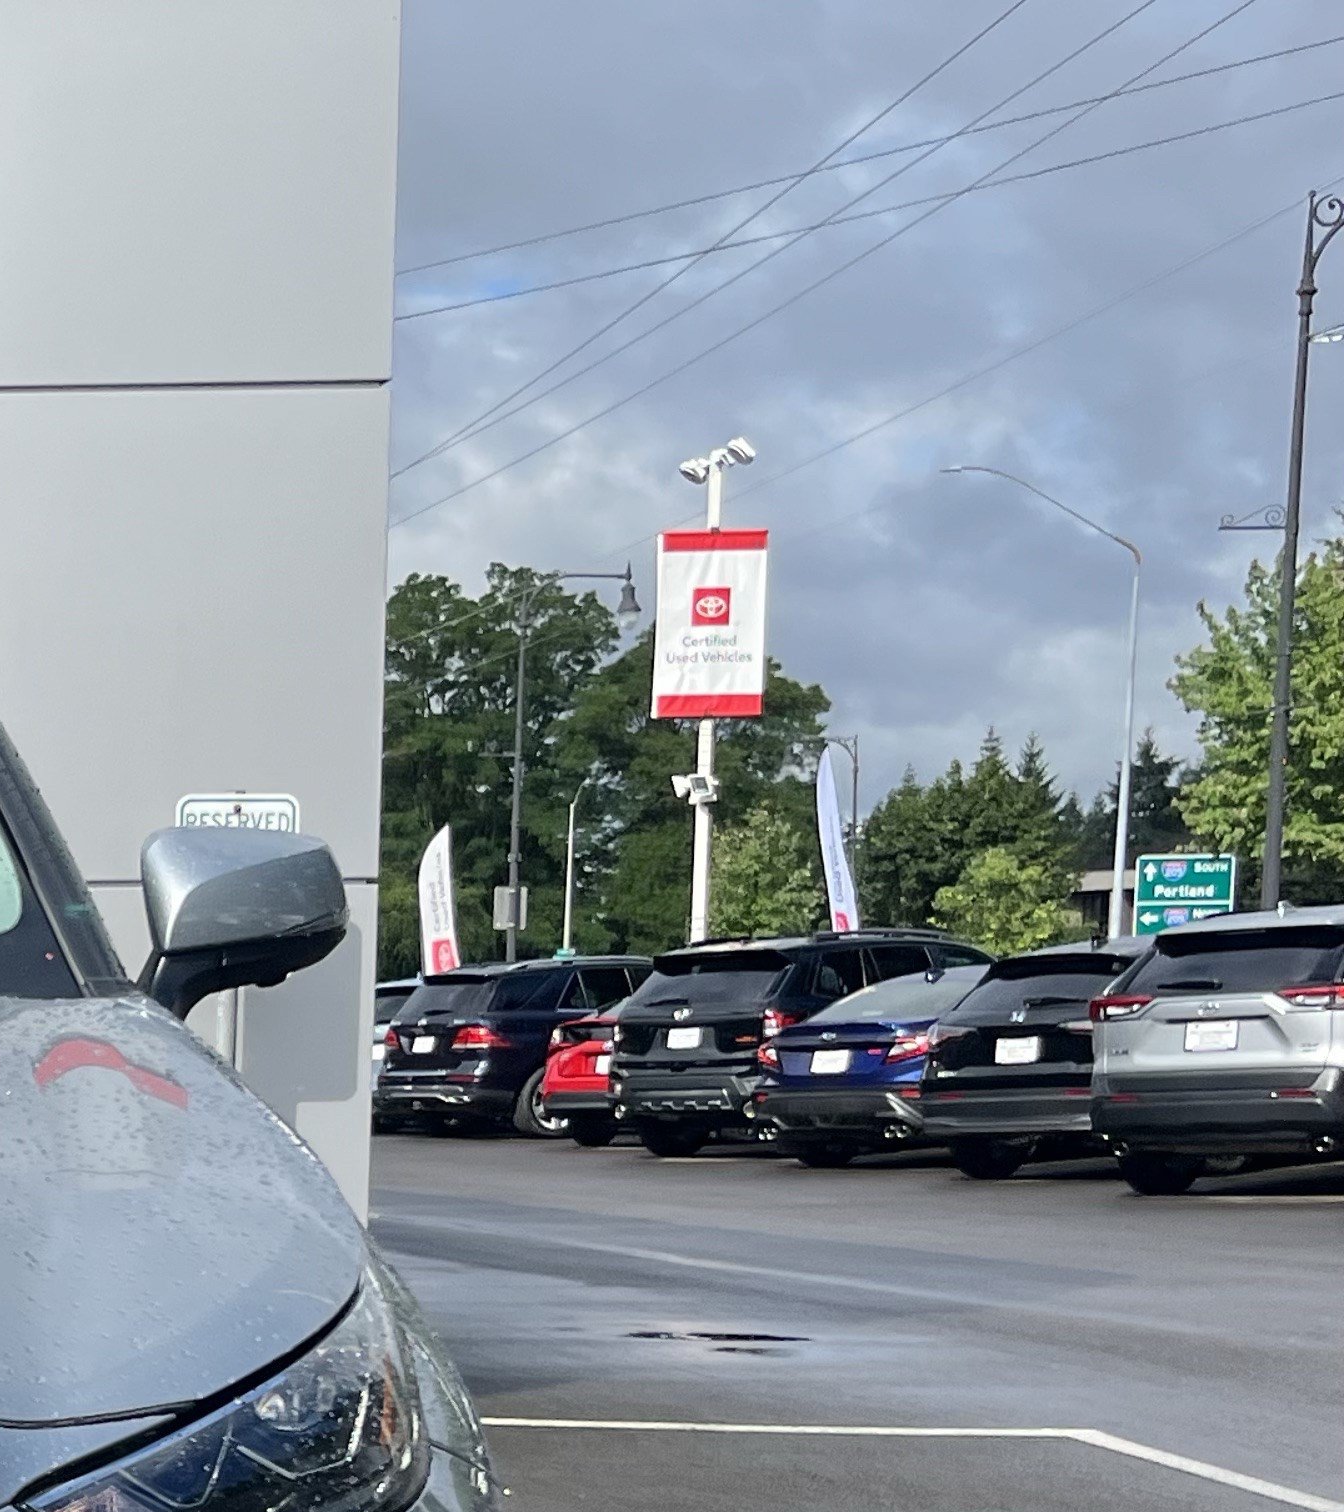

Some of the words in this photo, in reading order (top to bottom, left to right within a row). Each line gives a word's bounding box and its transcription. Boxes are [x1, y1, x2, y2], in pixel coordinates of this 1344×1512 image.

[682, 634, 737, 647] Certified
[666, 652, 699, 664] Used
[701, 651, 753, 663] Vehicles
[185, 812, 291, 832] RESERVED
[1154, 884, 1215, 898] Portland
